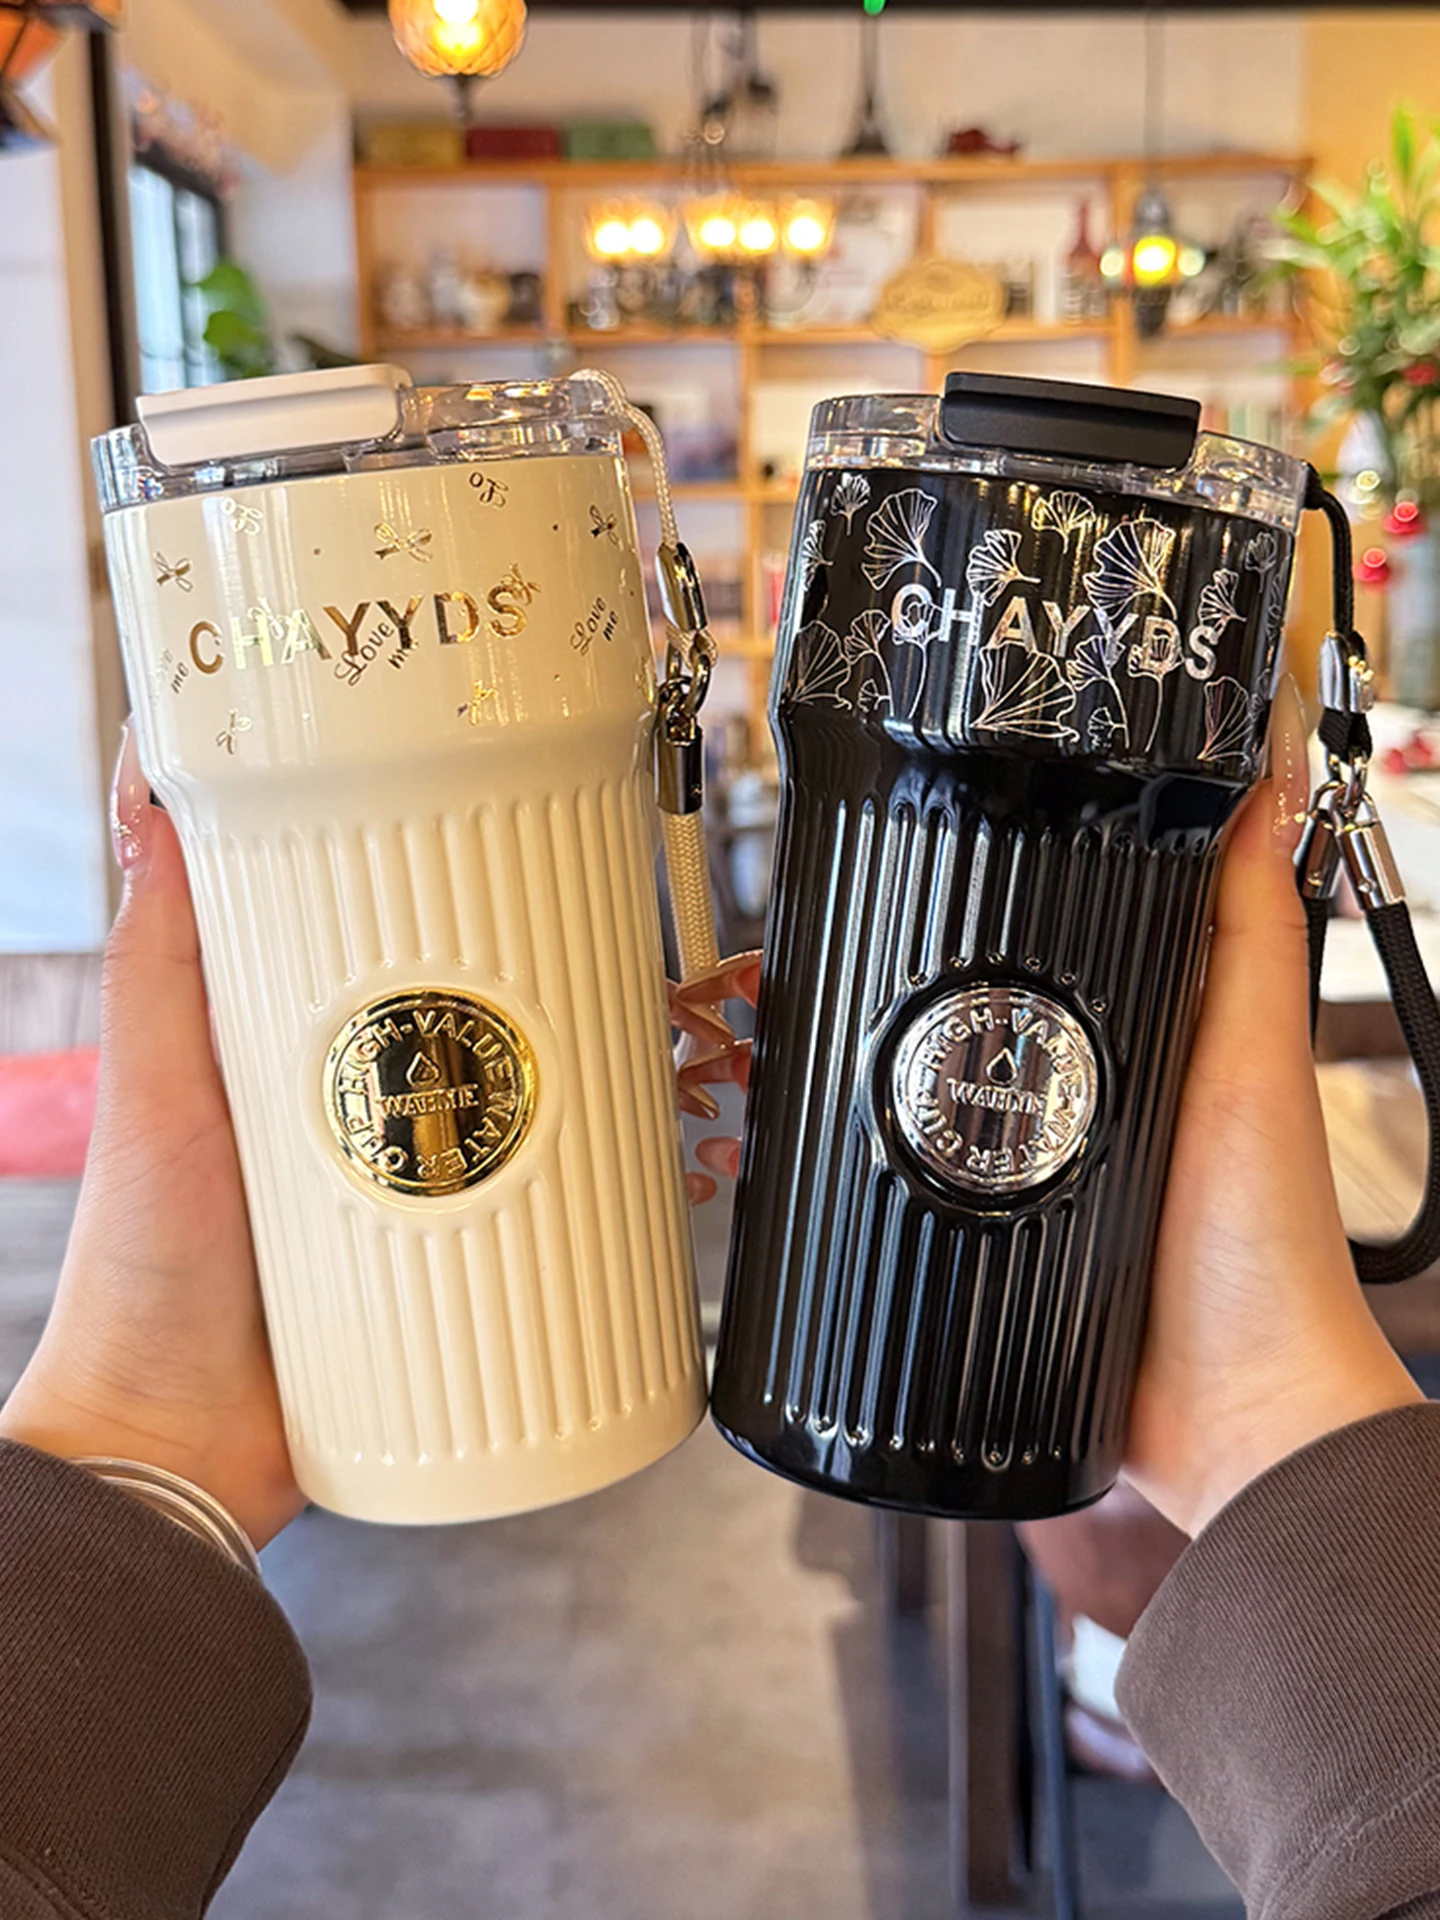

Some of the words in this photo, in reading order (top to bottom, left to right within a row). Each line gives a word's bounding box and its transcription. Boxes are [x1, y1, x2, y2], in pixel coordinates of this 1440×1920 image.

[189, 585, 530, 675] CHAYYDS
[333, 621, 395, 687] Love
[388, 638, 419, 670] m
[570, 596, 607, 656] Love
[602, 610, 620, 642] me
[889, 583, 1218, 681] CHAYYDS
[170, 661, 190, 695] me
